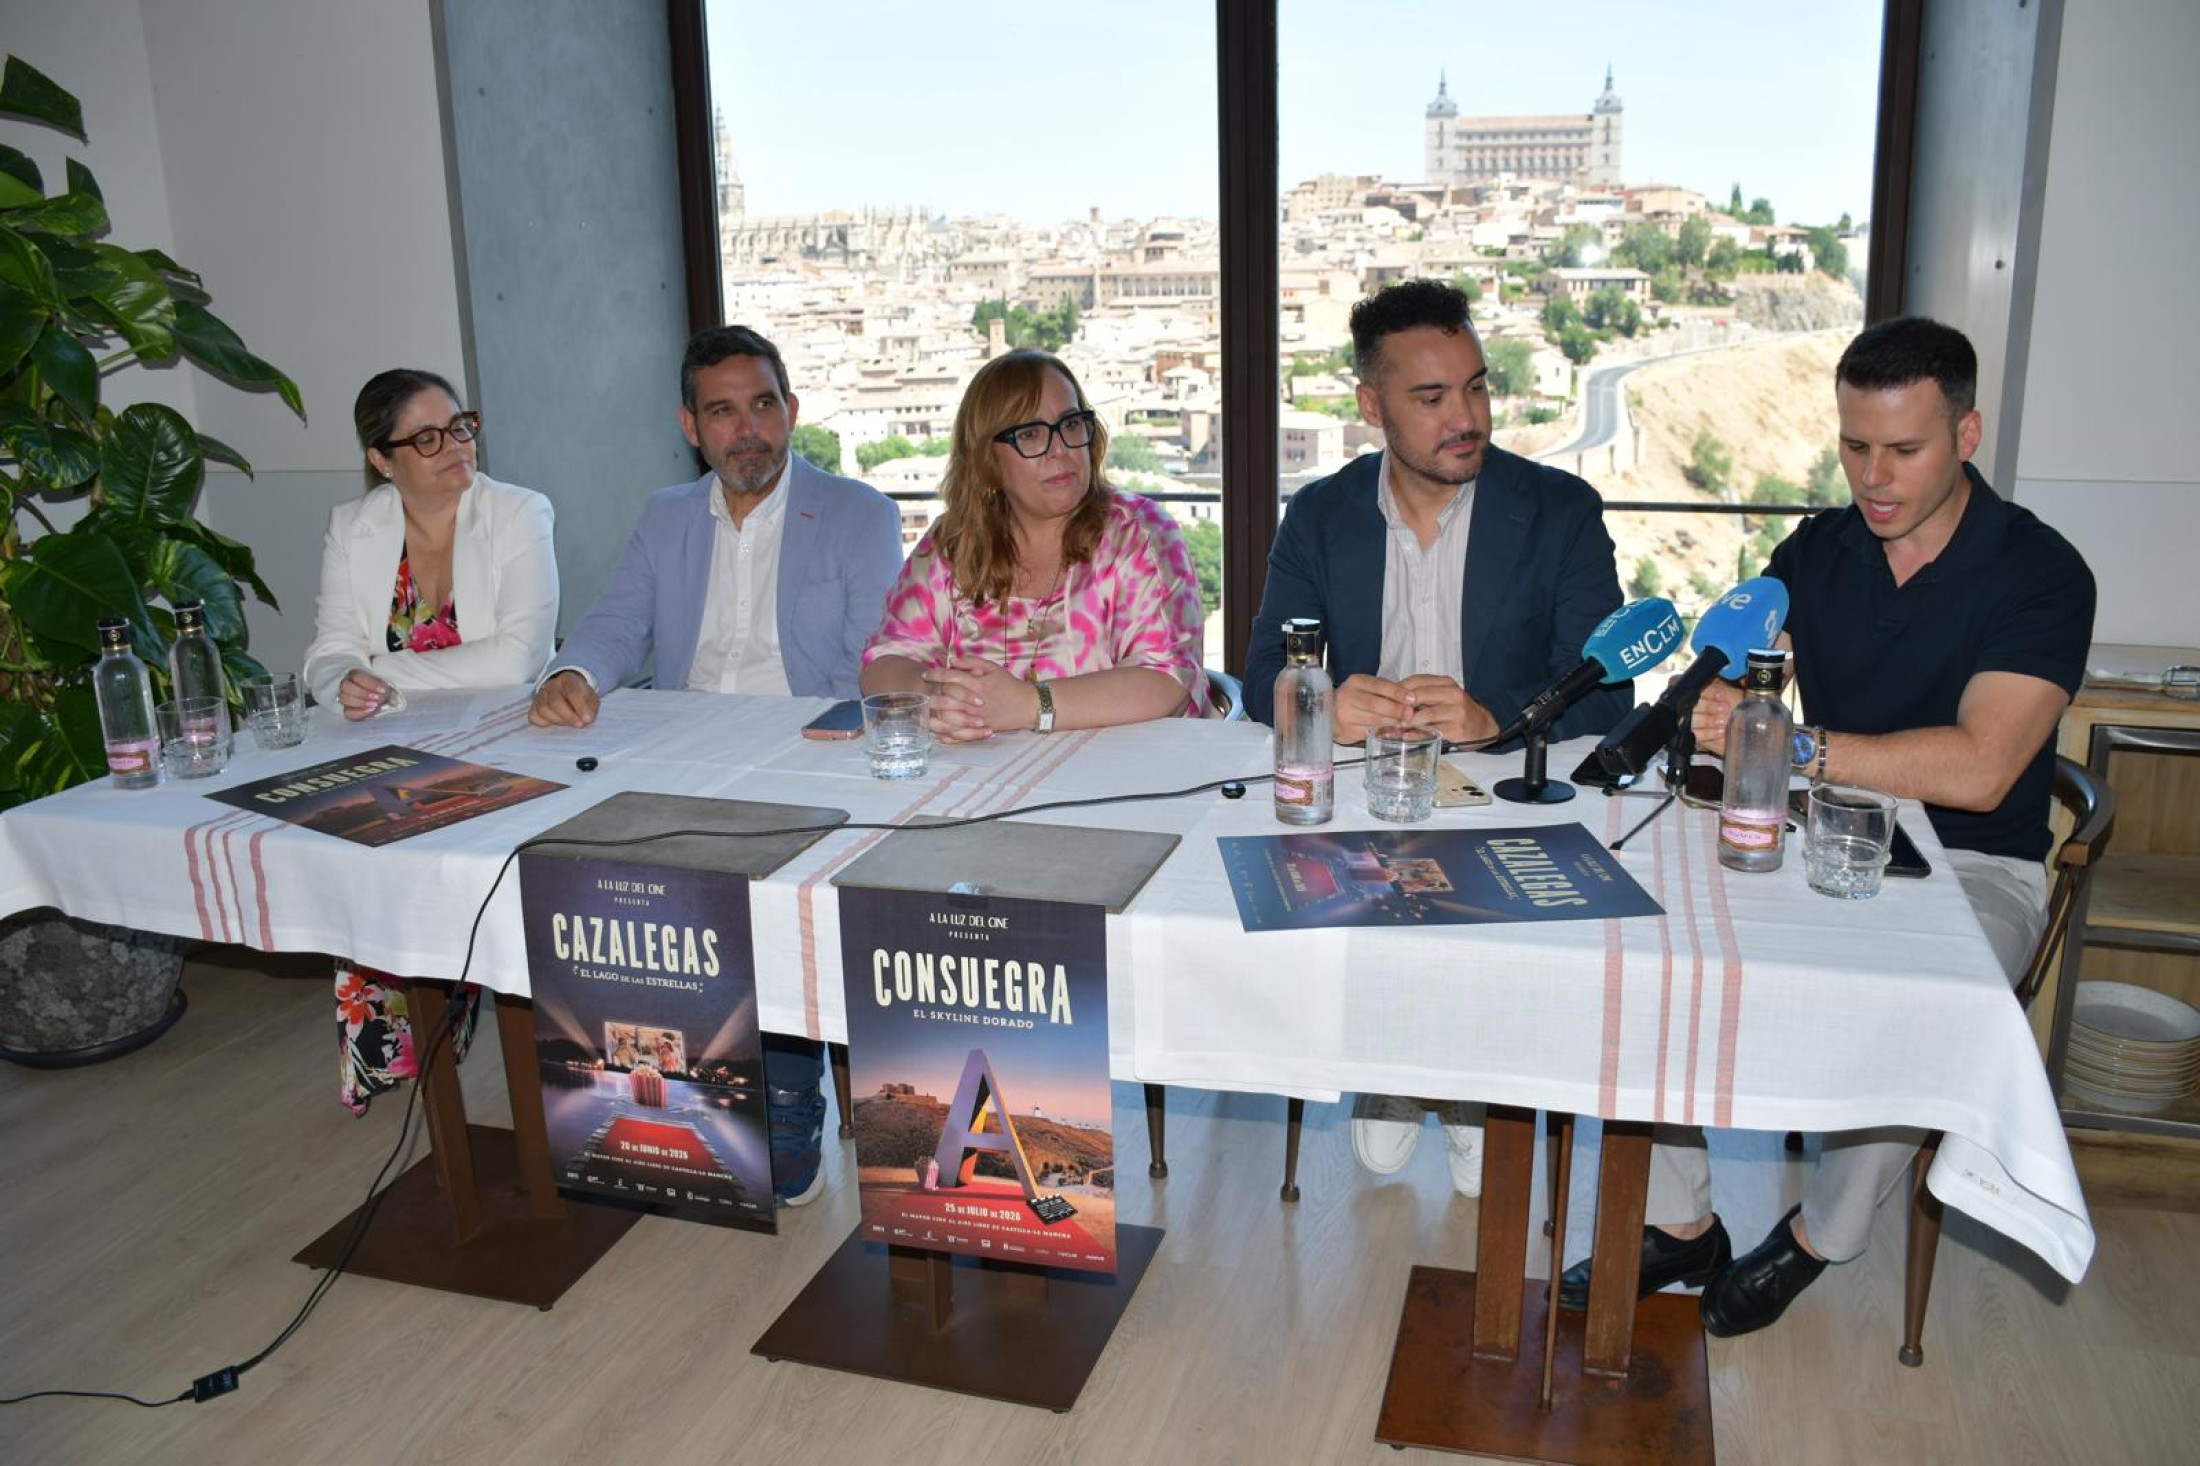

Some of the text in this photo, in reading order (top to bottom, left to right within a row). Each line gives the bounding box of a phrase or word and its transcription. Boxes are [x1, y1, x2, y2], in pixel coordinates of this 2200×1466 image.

[255, 757, 419, 803] CONSUEGRA
[597, 879, 666, 896] A LA LUZ DEL CINE
[1486, 838, 1588, 907] CAZALEGAS
[929, 912, 1009, 929] A LA LUZ DEL CINE
[552, 912, 720, 978] CAZALEGAS
[580, 968, 592, 979] EL
[593, 970, 619, 982] LAGO
[645, 976, 699, 992] ESTRELLAS
[872, 948, 1073, 1025] CONSUEGRA
[913, 1008, 1035, 1030] EL SKYLINE DORADO
